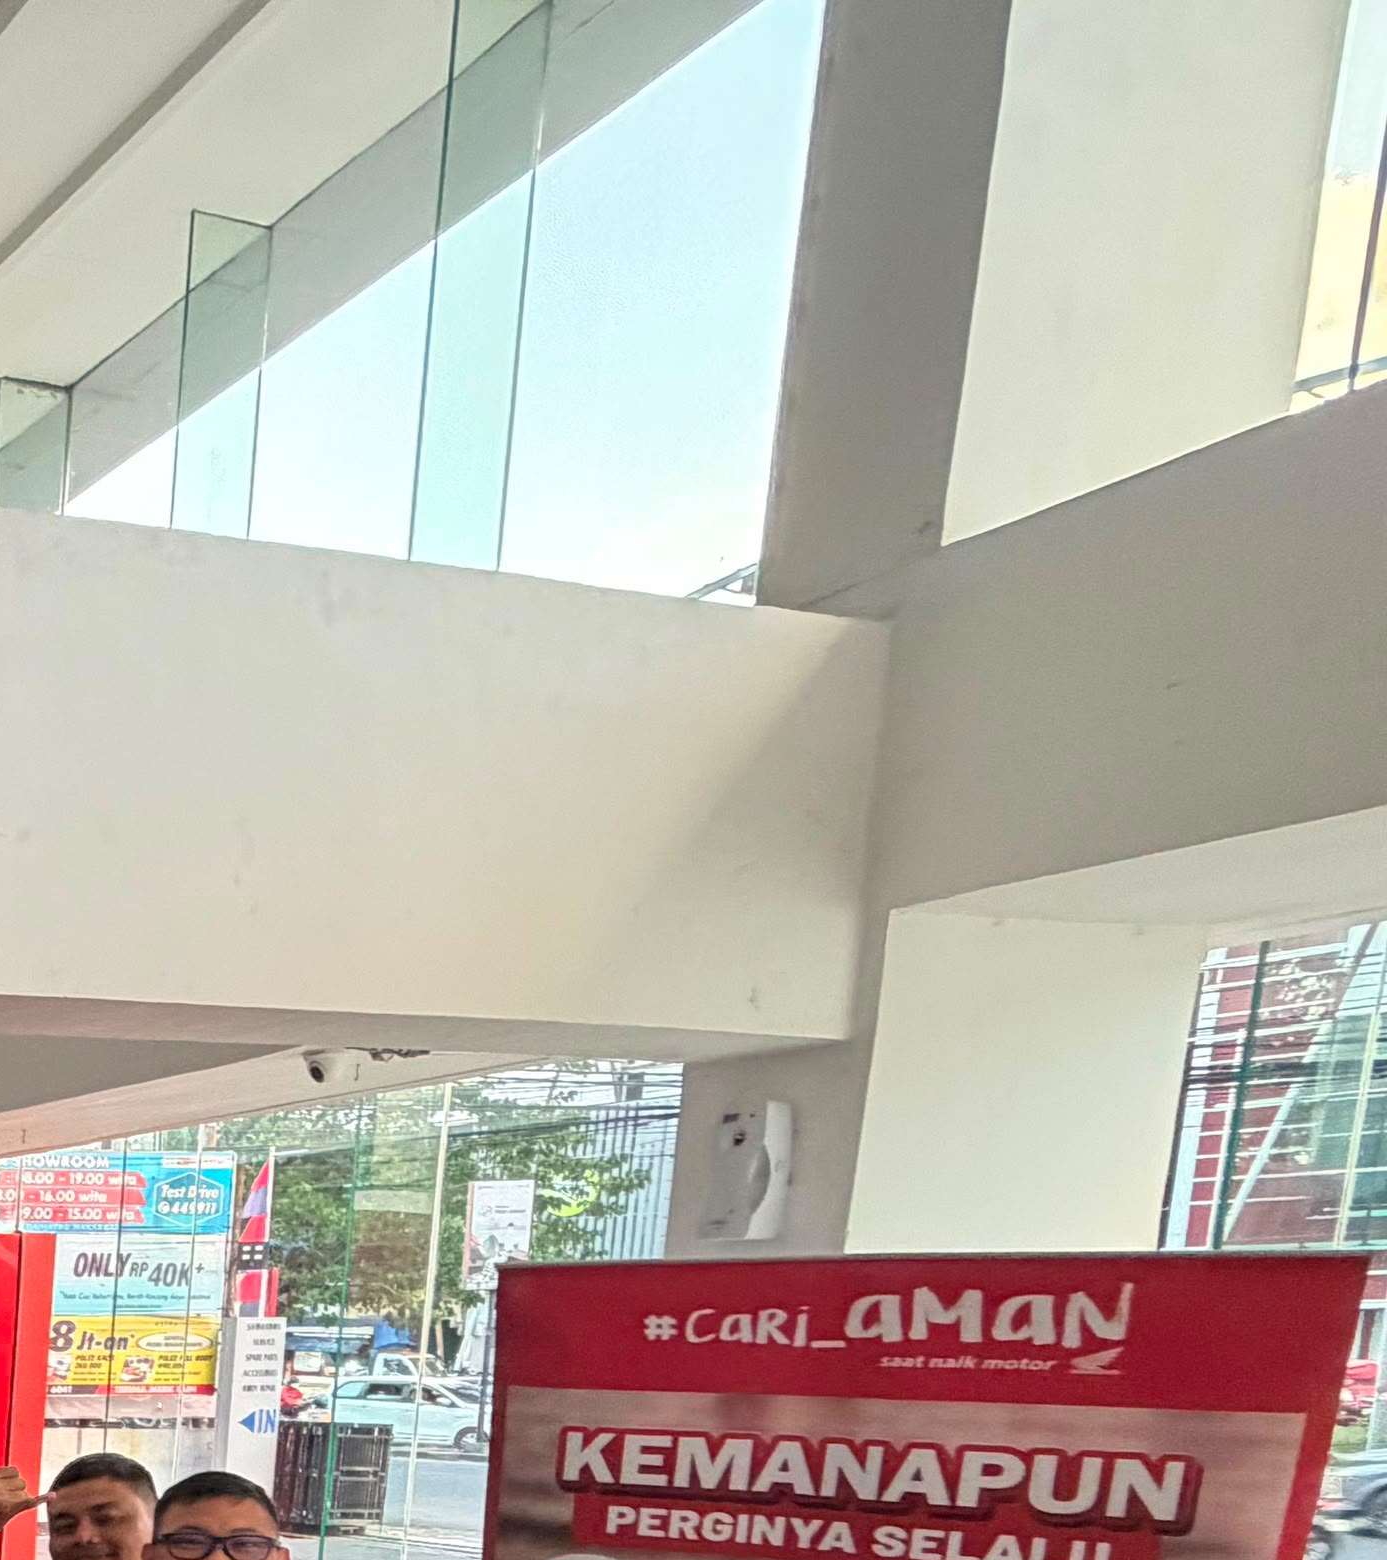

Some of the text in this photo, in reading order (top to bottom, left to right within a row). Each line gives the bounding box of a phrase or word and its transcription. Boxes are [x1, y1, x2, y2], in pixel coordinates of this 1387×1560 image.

[69, 1172, 105, 1185] 19.00
[108, 1174, 137, 1186] wita
[39, 1190, 76, 1201] 16.00
[79, 1190, 108, 1202] wita
[161, 1185, 220, 1199] Test Drive
[68, 1208, 102, 1220] 15.00
[106, 1209, 135, 1221] wita
[73, 1252, 132, 1278] ONLY
[129, 1261, 149, 1278] RP
[880, 1353, 1059, 1371] saat naik motor
[257, 1408, 277, 1434] IN
[561, 1431, 1187, 1522] KEMANAPUN
[605, 1504, 858, 1554] PERGINYA
